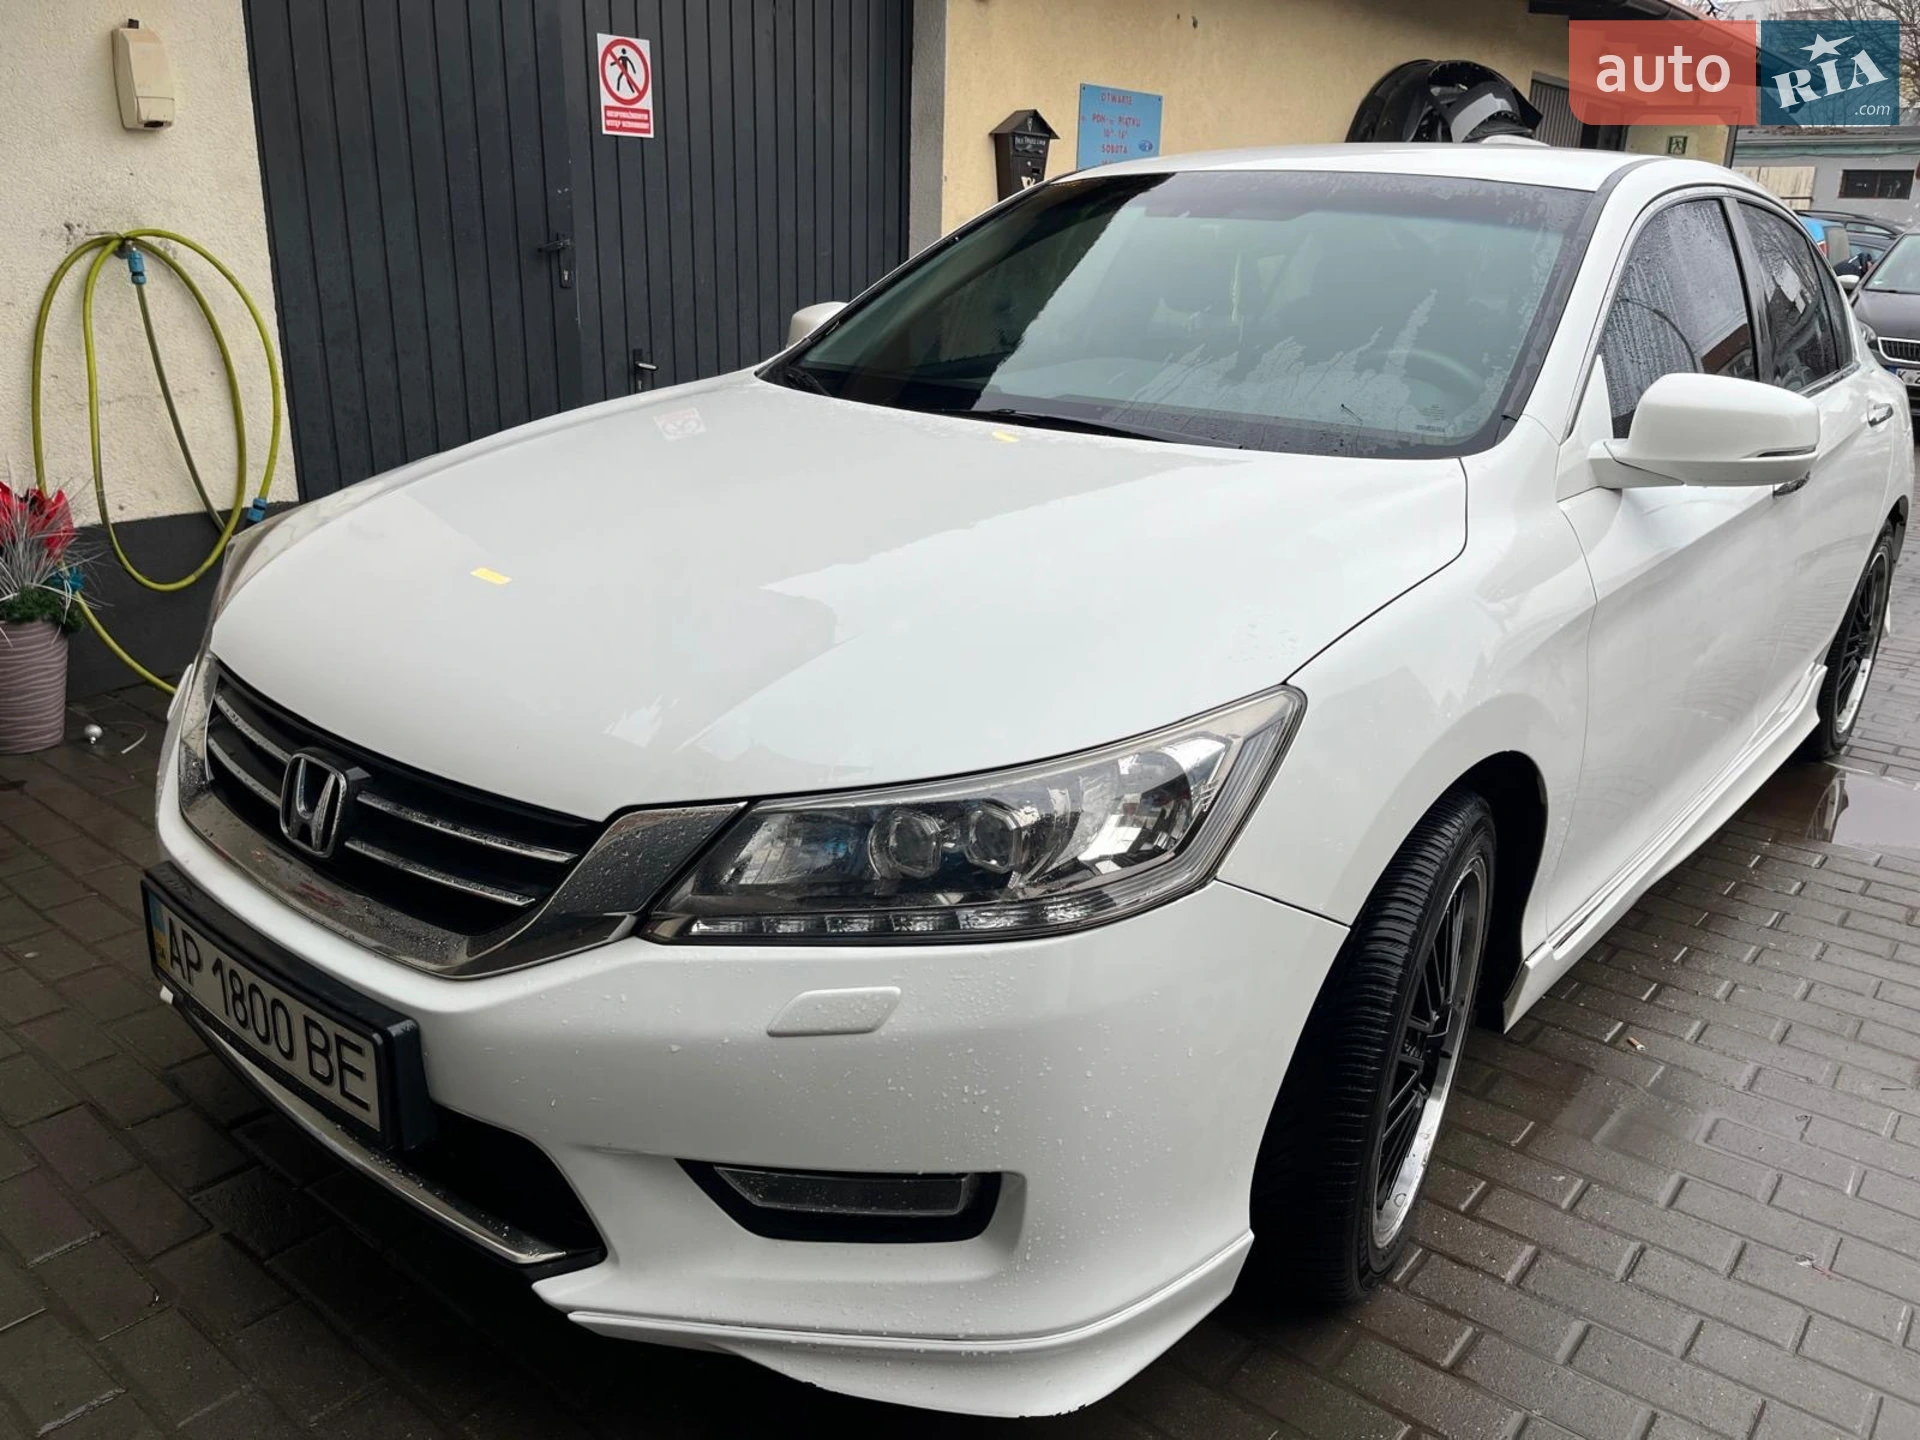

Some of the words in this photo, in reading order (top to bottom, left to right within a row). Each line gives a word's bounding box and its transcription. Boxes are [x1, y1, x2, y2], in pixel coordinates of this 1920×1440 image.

[168, 917, 204, 985] AP
[211, 957, 296, 1062] 1800
[303, 1013, 371, 1113] BE
